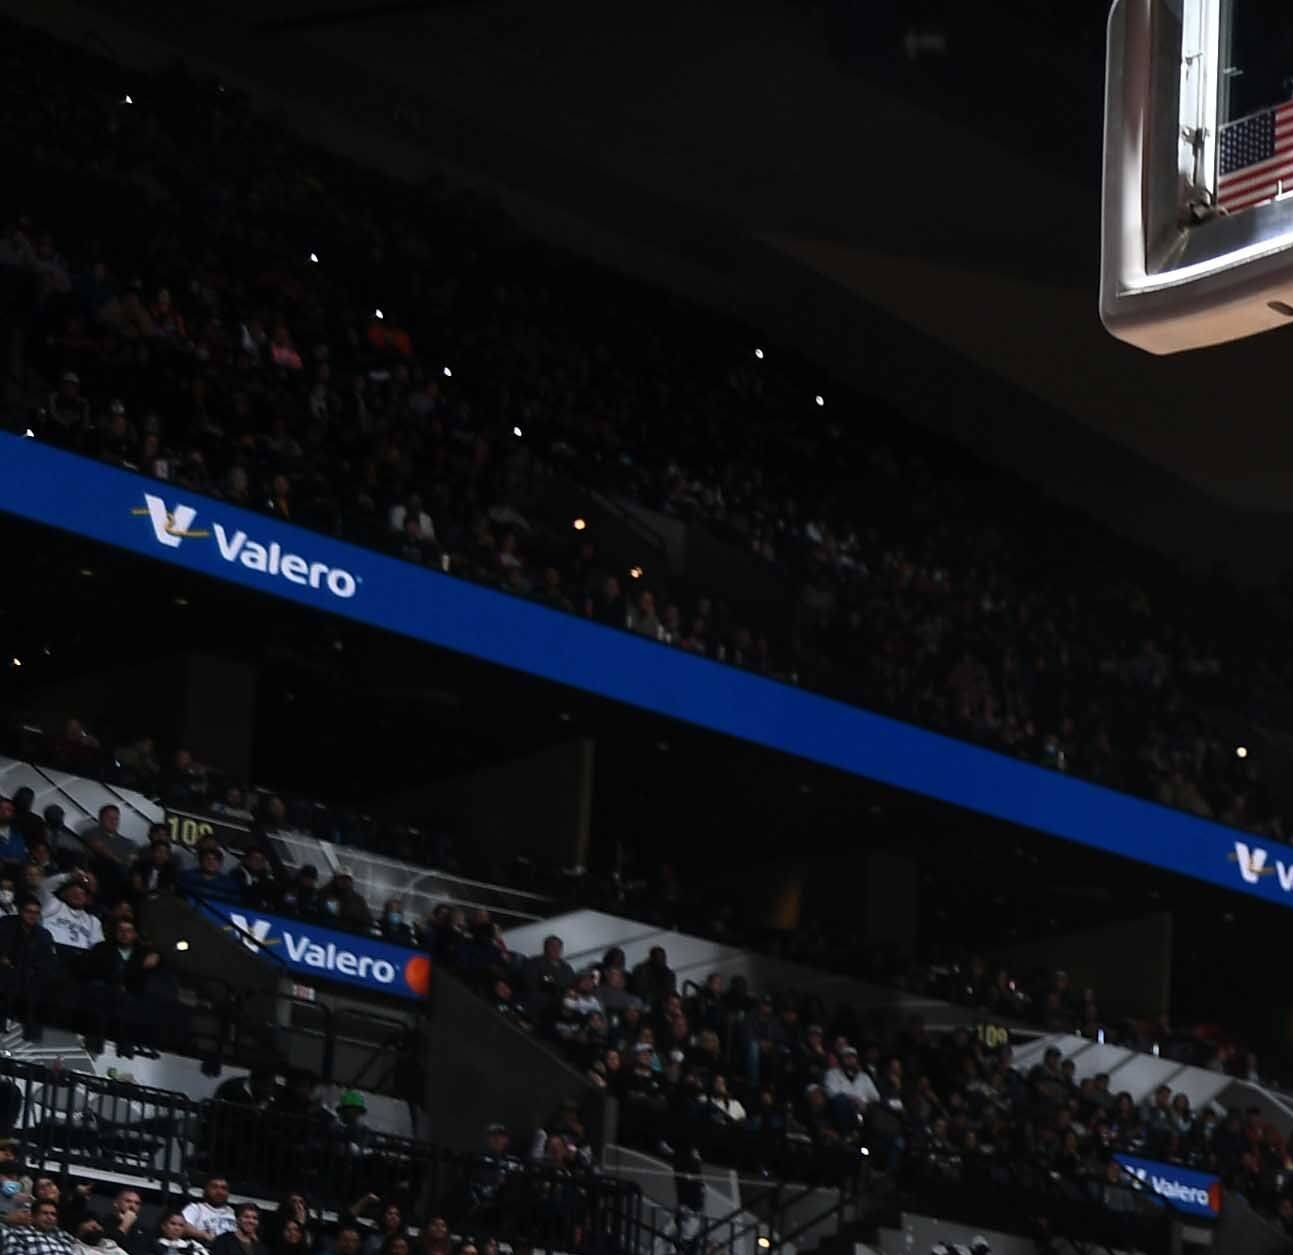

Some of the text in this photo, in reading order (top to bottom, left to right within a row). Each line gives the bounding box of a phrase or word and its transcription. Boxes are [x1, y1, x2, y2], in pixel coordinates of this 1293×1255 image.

[212, 521, 357, 599] Valero
[281, 930, 396, 985] Valero
[1150, 1175, 1209, 1208] Valero
